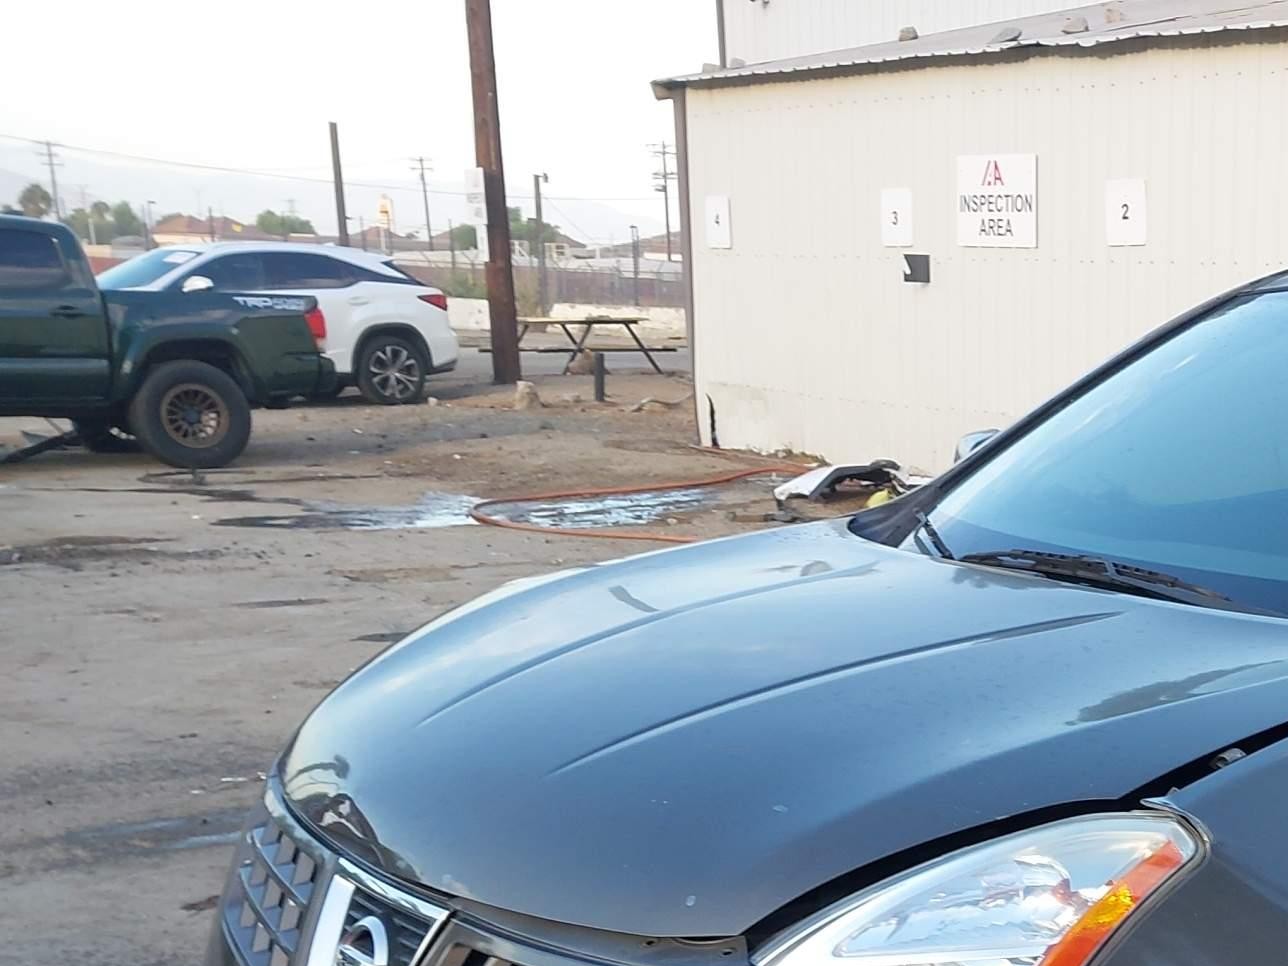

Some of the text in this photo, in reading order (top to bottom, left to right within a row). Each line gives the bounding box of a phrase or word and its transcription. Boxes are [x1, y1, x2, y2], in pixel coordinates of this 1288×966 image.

[960, 194, 1033, 213] INSPECTION
[1121, 203, 1130, 220] 2
[891, 210, 899, 226] 3
[979, 218, 1014, 236] AREA
